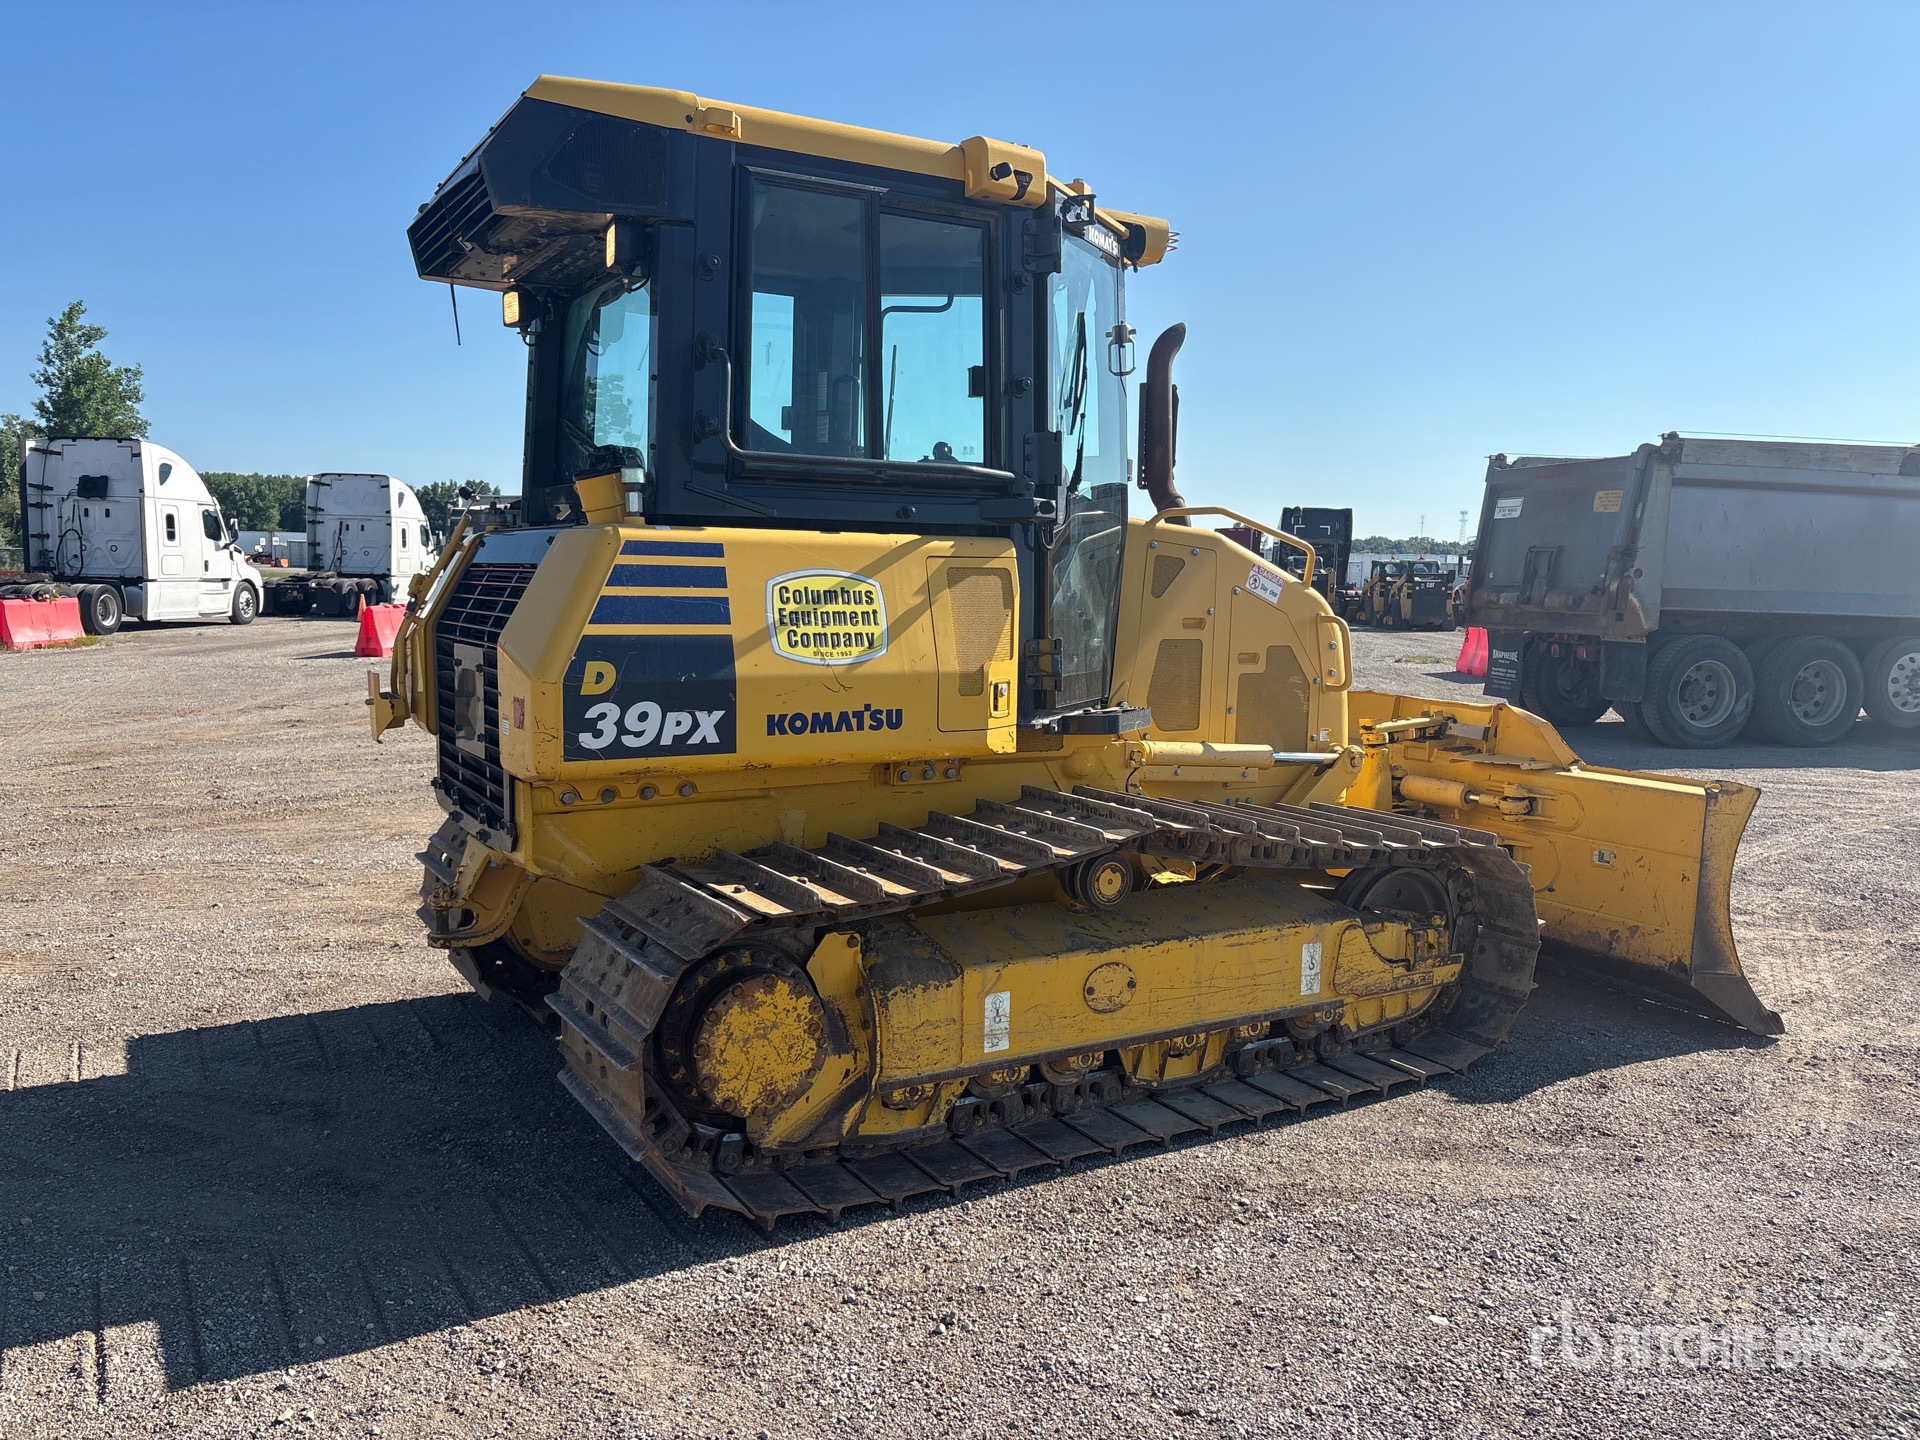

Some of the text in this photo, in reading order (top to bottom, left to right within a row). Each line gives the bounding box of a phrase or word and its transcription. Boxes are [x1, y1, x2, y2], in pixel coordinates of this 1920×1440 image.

[1259, 566, 1285, 587] DANGER
[778, 585, 875, 606] Columbus
[1260, 582, 1279, 598] Stay clear
[778, 607, 879, 628] Equipment
[787, 629, 875, 649] Company
[836, 650, 852, 658] 1952
[1492, 648, 1518, 662] KNAPHEIDE
[580, 661, 617, 696] D
[578, 700, 726, 750] 39PX
[766, 703, 903, 736] KOMATSU
